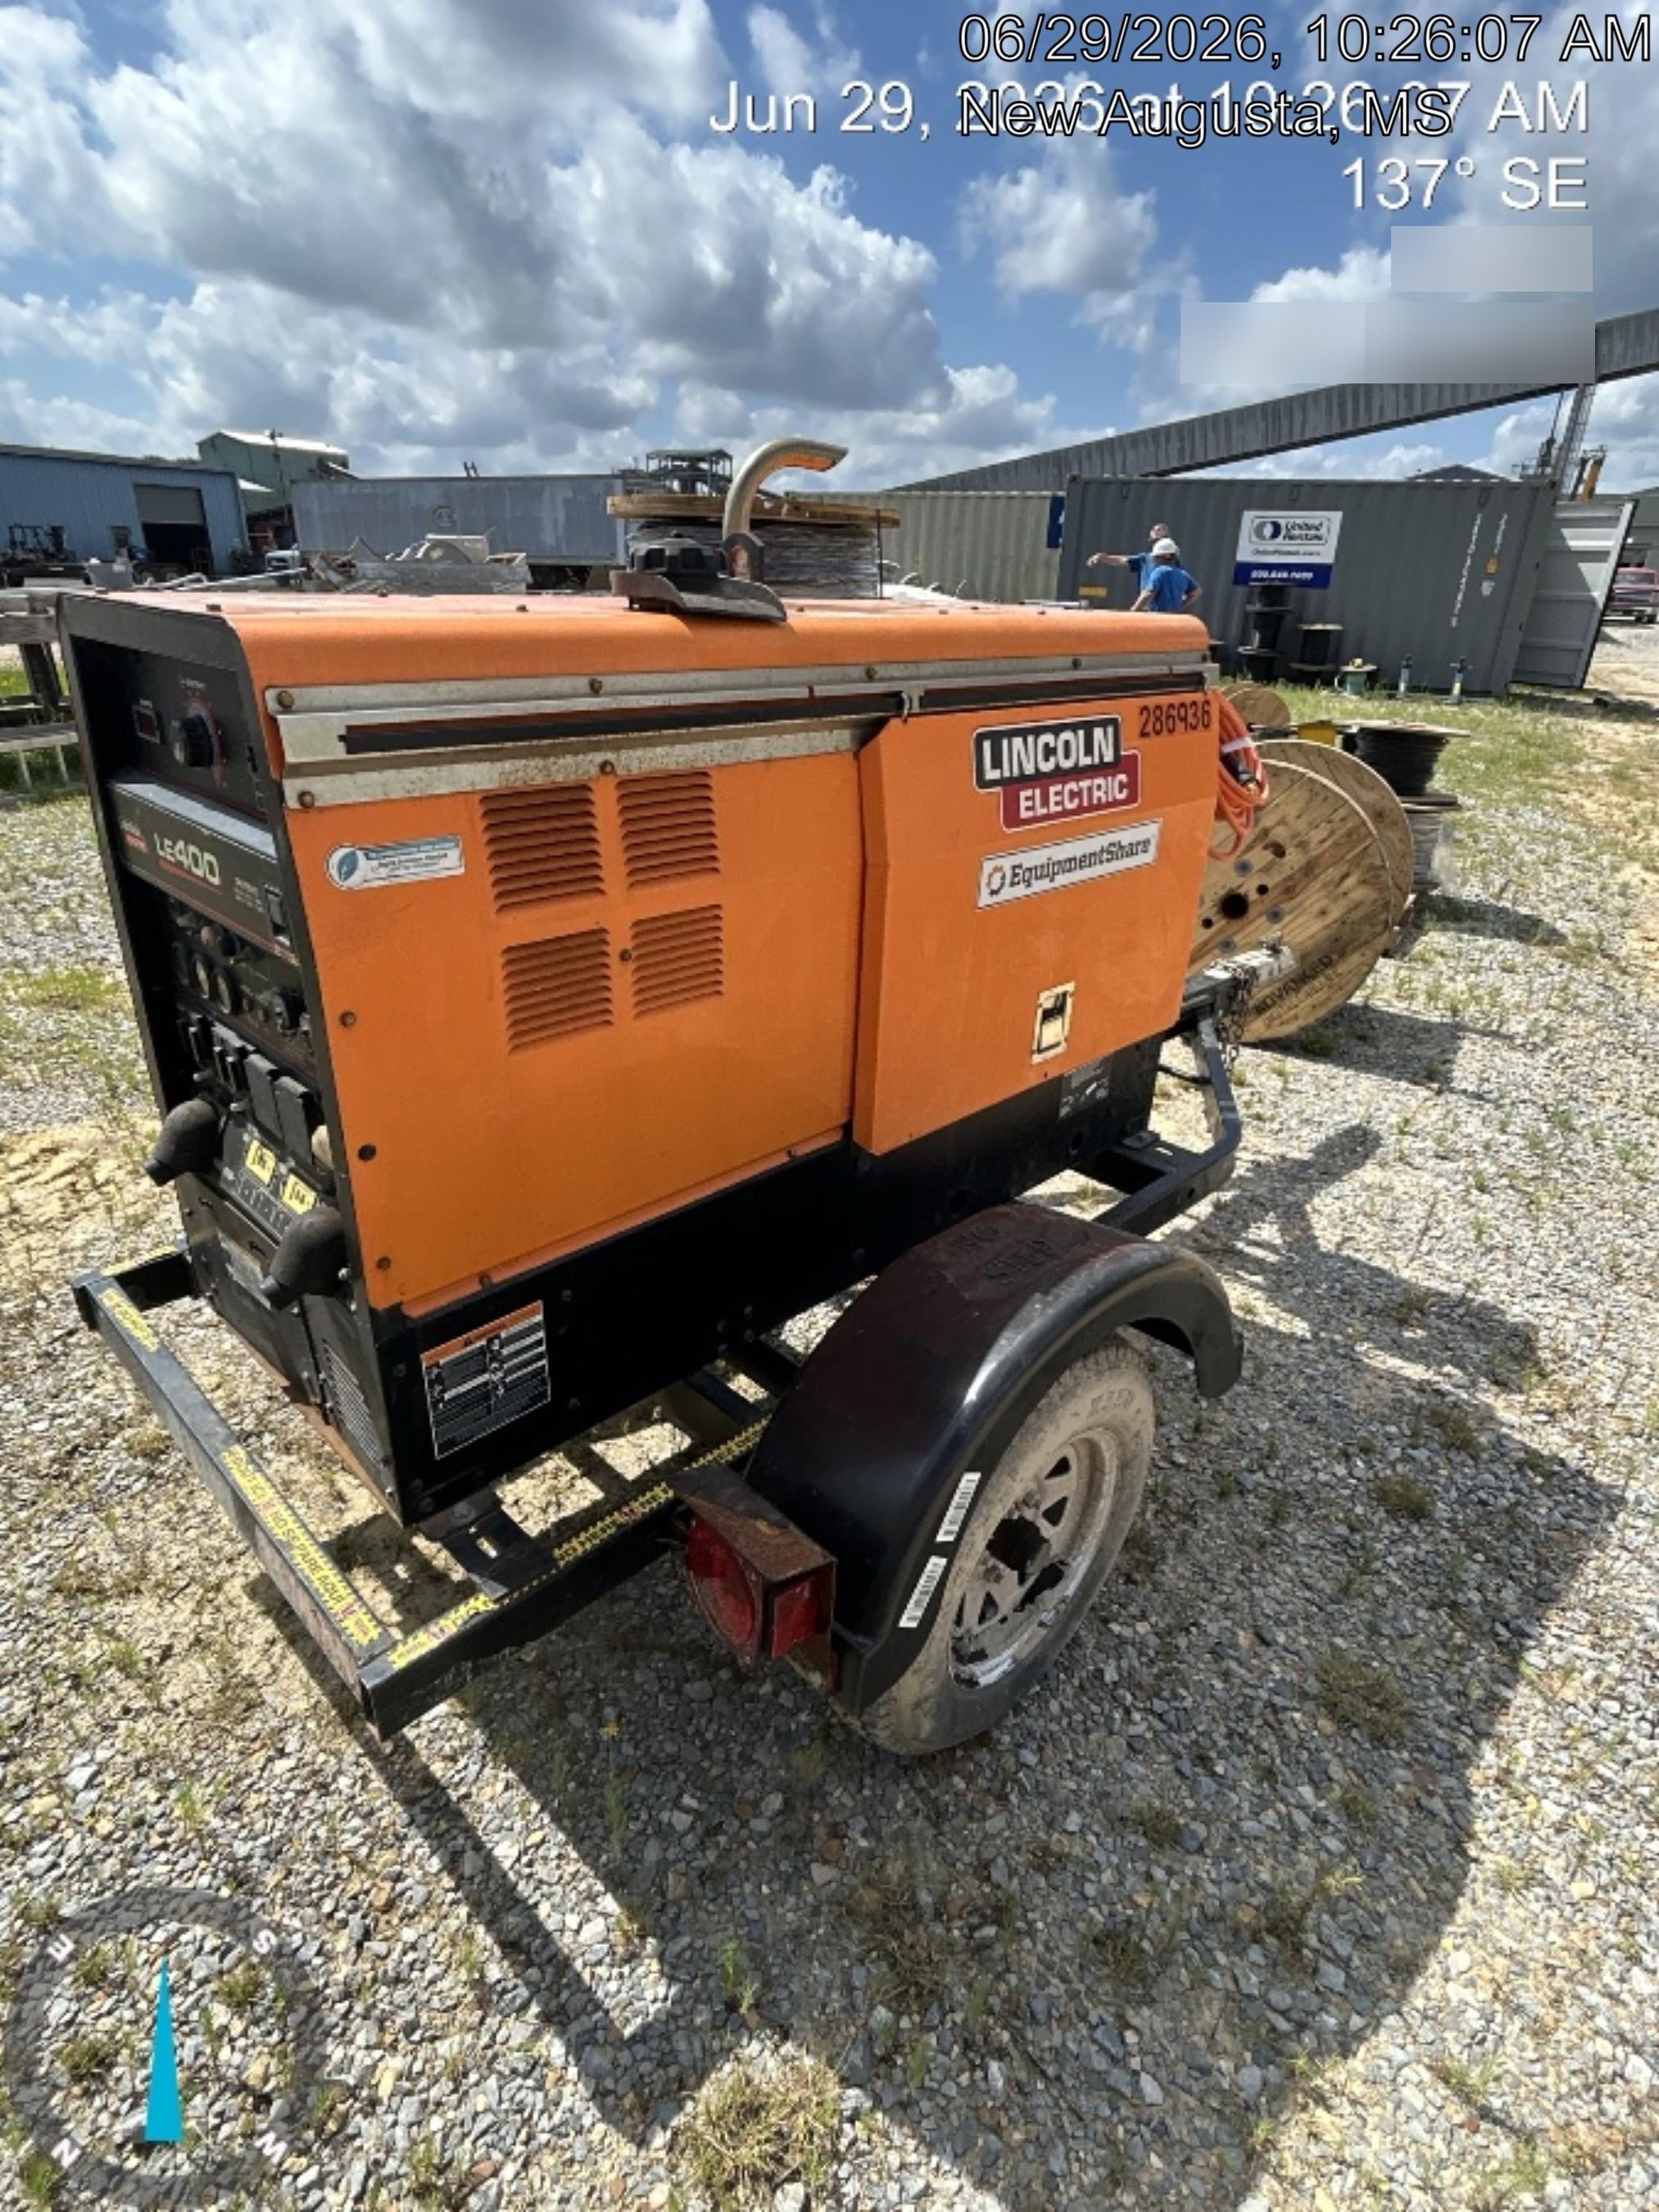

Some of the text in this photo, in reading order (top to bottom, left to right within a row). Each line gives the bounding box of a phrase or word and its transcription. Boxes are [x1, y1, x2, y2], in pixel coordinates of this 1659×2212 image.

[1140, 700, 1211, 738] 286936
[983, 725, 1115, 780] LINCOLN
[1019, 773, 1129, 819] ELECTRIC
[1009, 836, 1151, 888] EquipmentShare
